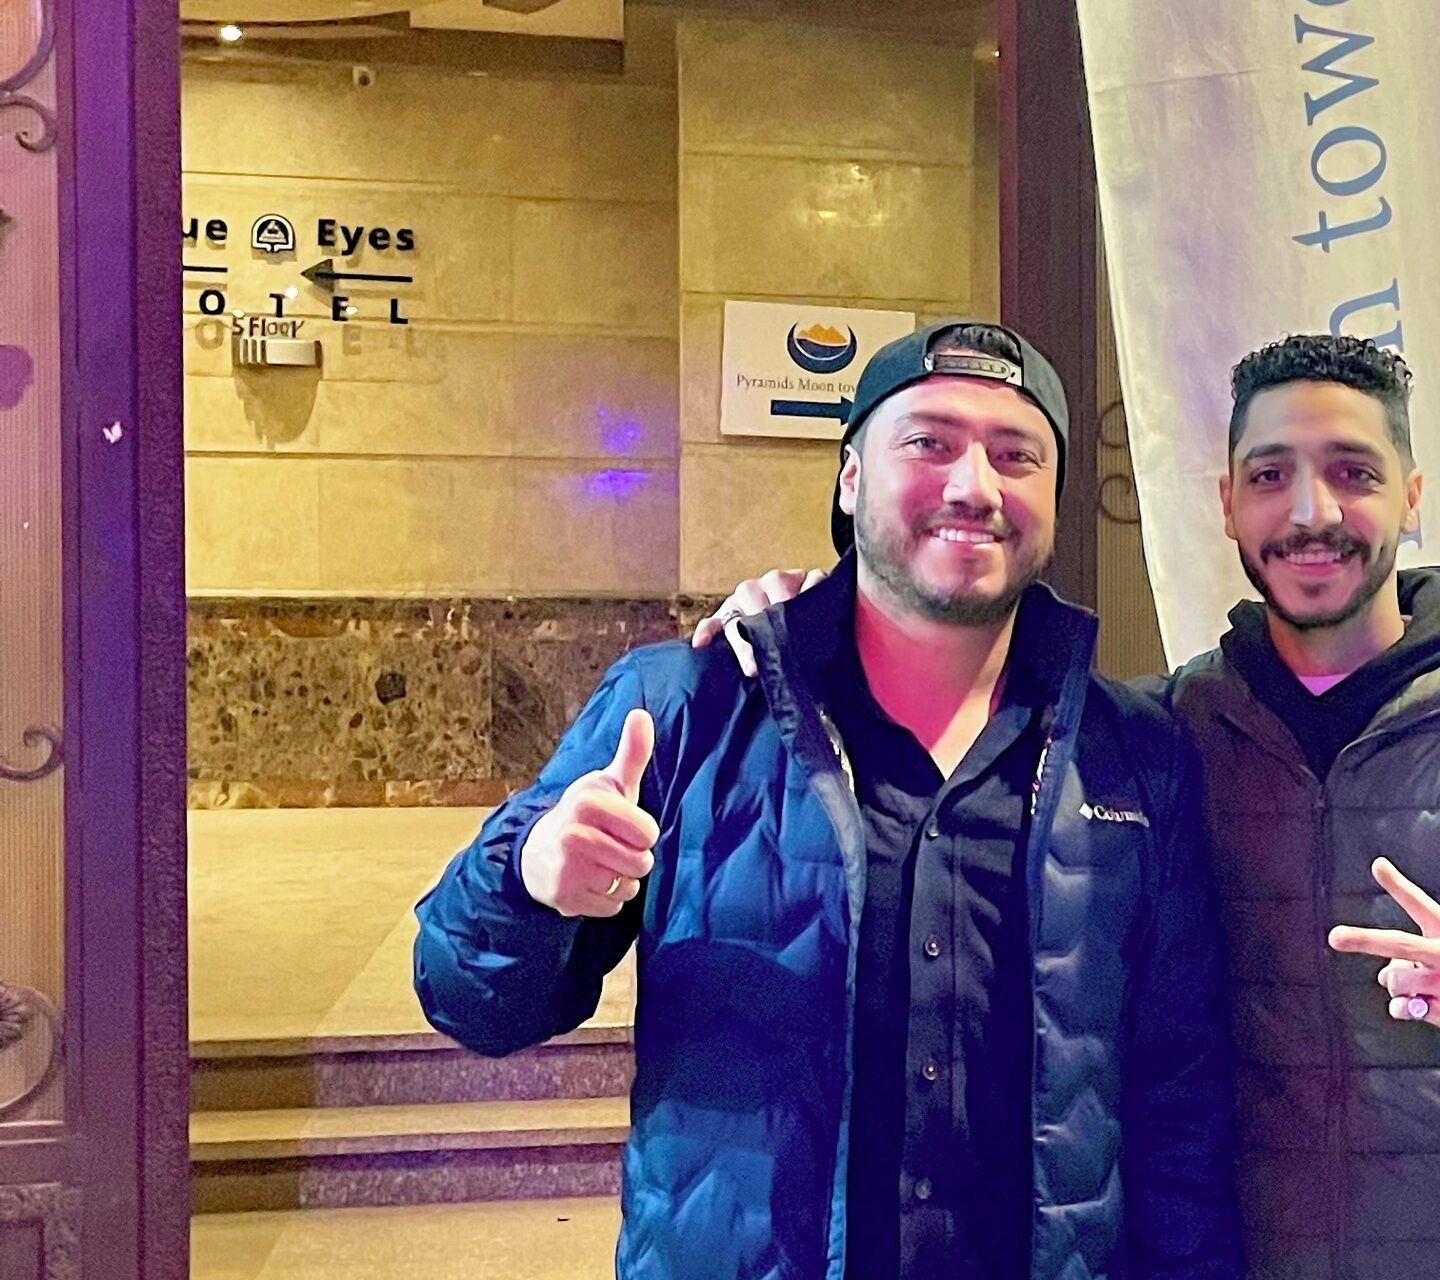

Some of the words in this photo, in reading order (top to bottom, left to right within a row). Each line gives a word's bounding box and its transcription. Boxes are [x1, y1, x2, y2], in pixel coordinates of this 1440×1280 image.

[183, 218, 229, 241] ue
[317, 218, 415, 257] Eyes
[198, 288, 409, 325] OTEL
[248, 316, 305, 339] Floor
[736, 373, 795, 393] Pyramids
[799, 377, 835, 392] Moon
